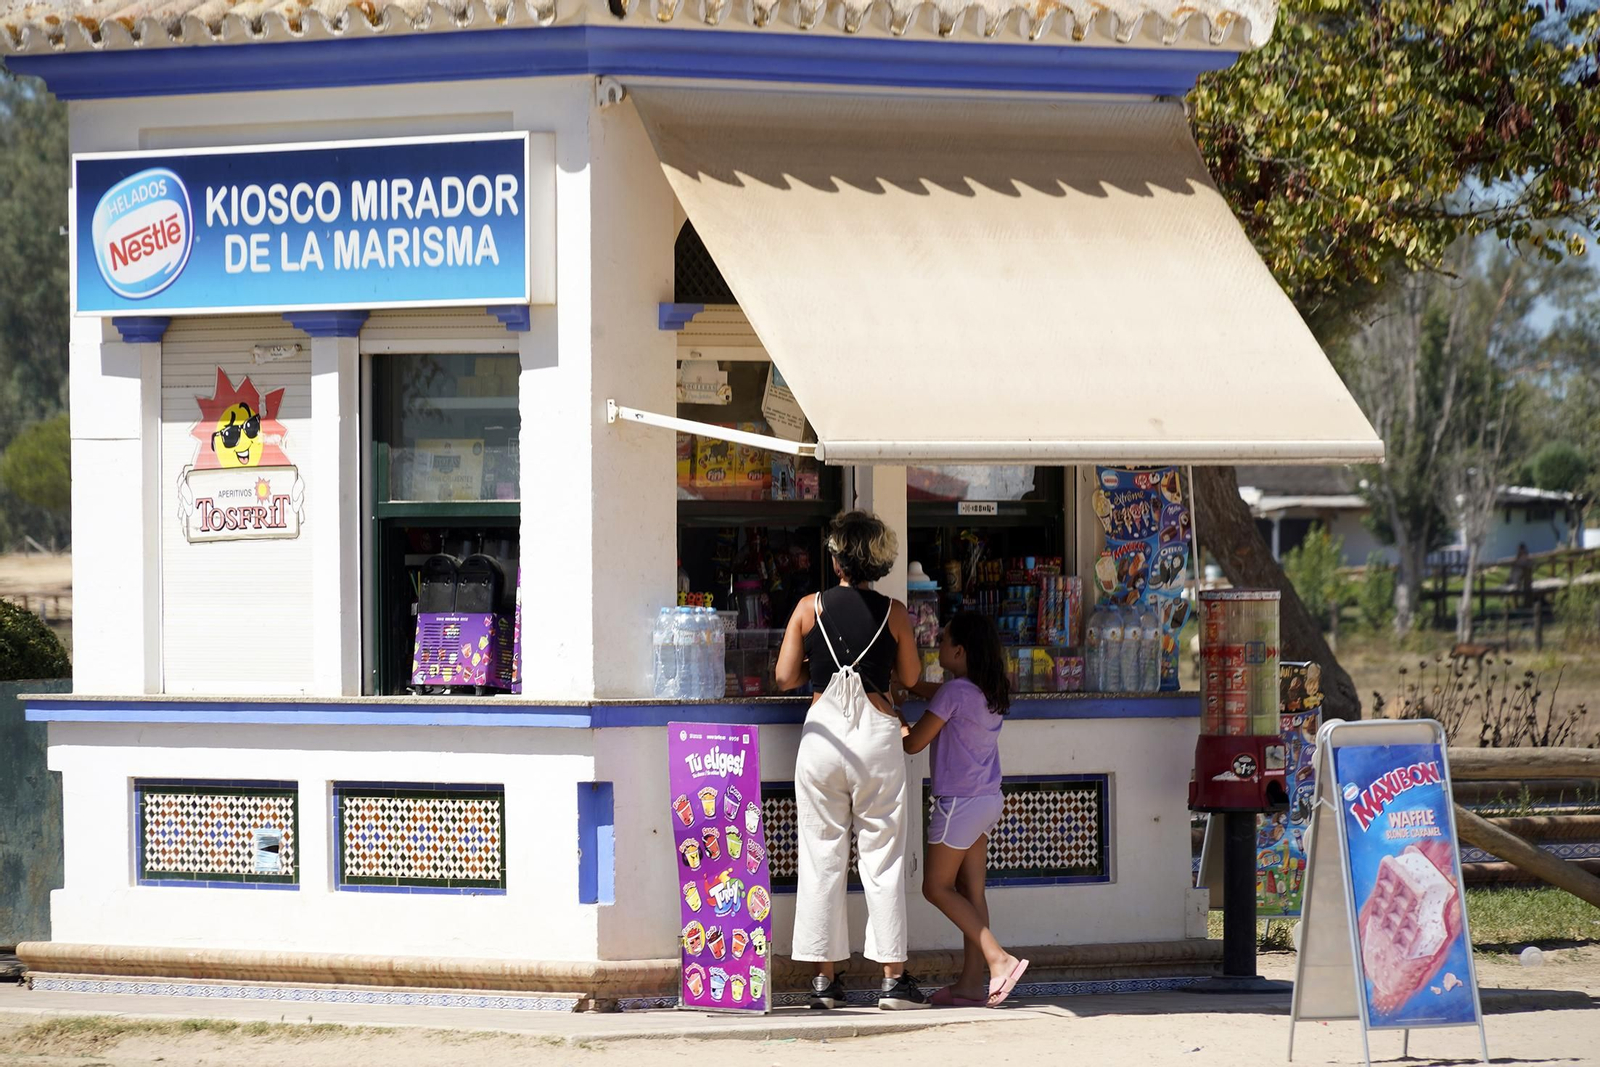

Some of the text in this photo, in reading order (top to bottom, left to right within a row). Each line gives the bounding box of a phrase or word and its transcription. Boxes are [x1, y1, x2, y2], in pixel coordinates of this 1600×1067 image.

[106, 179, 168, 218] HELADOS
[205, 174, 519, 227] KIOSCO MIRADOR
[225, 224, 500, 274] DE LA MARISMA
[218, 488, 253, 499] APERITIVOS
[195, 494, 292, 533] TOSFRIT
[685, 745, 746, 778] Tú eliges!
[1350, 762, 1441, 833] MAXIBON
[1386, 827, 1442, 840] BLONDE CARAMEL
[1388, 809, 1435, 828] WAFFLE
